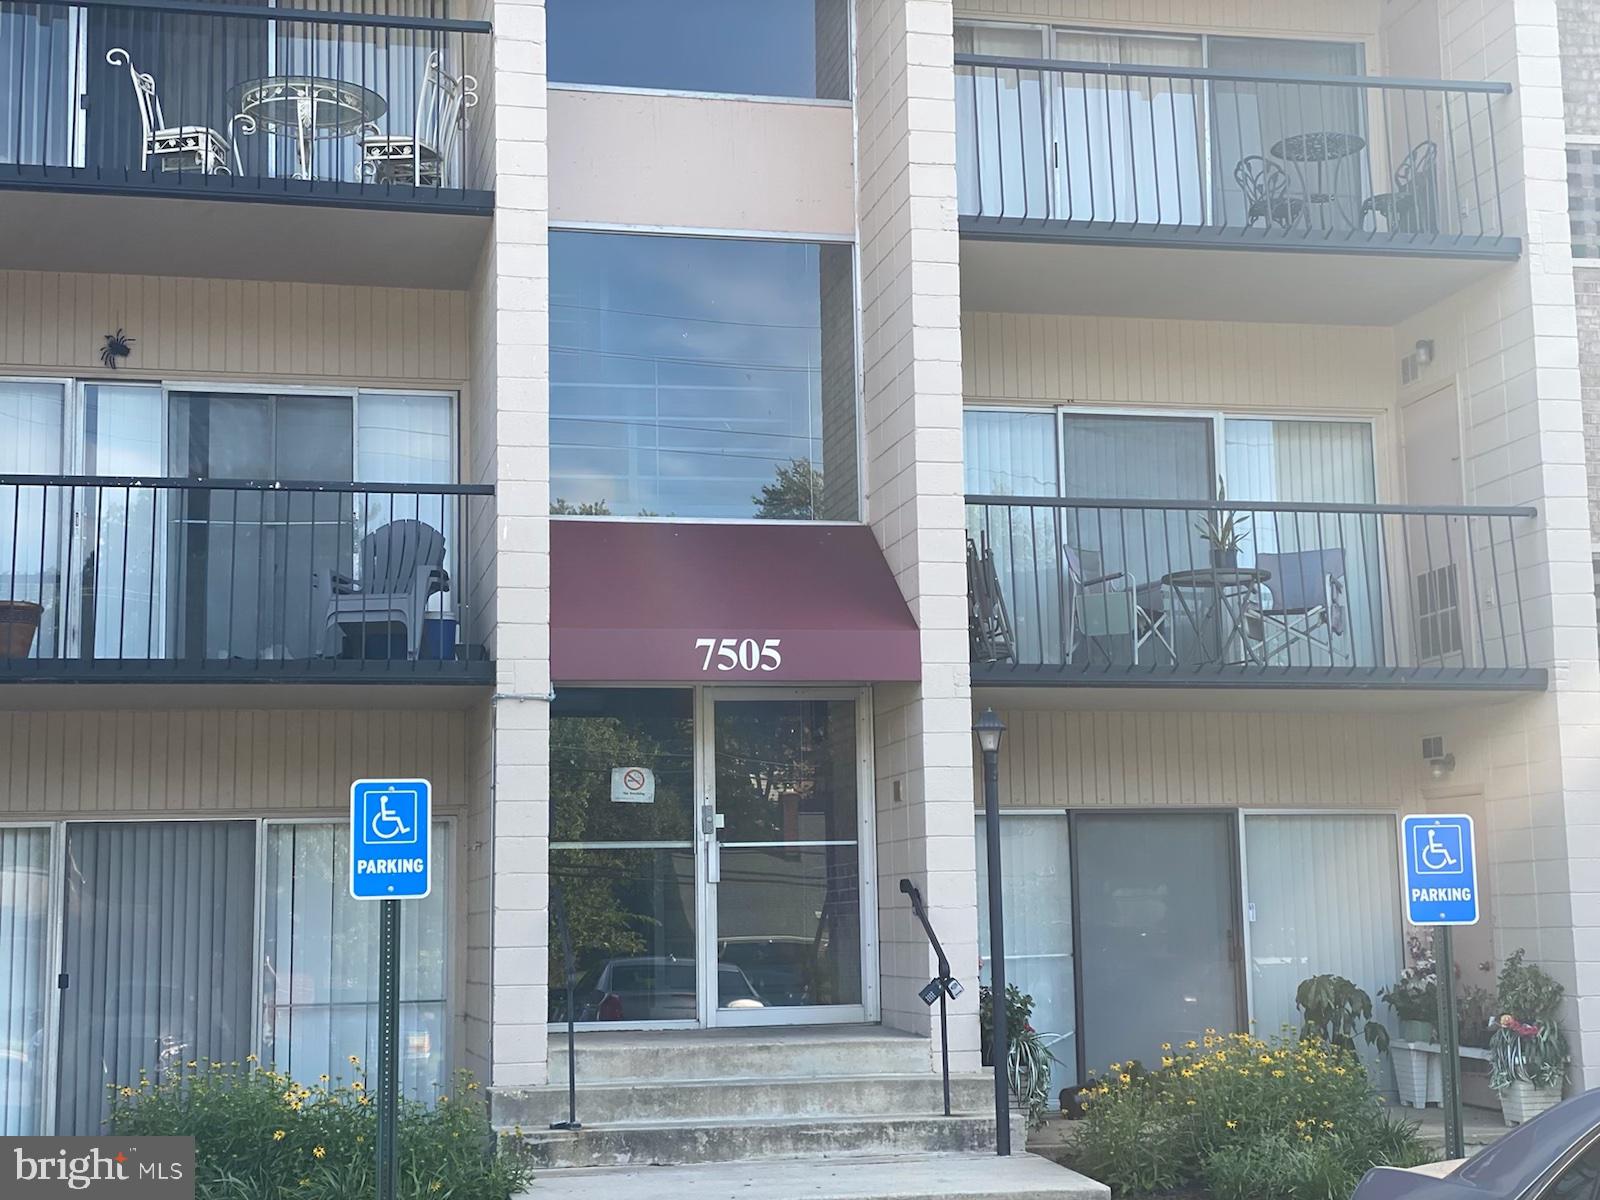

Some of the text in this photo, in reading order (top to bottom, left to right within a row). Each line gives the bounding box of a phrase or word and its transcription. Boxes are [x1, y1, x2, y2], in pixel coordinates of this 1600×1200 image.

[695, 638, 781, 671] 7505
[357, 858, 424, 874] PARKING
[1412, 887, 1472, 902] PARKING
